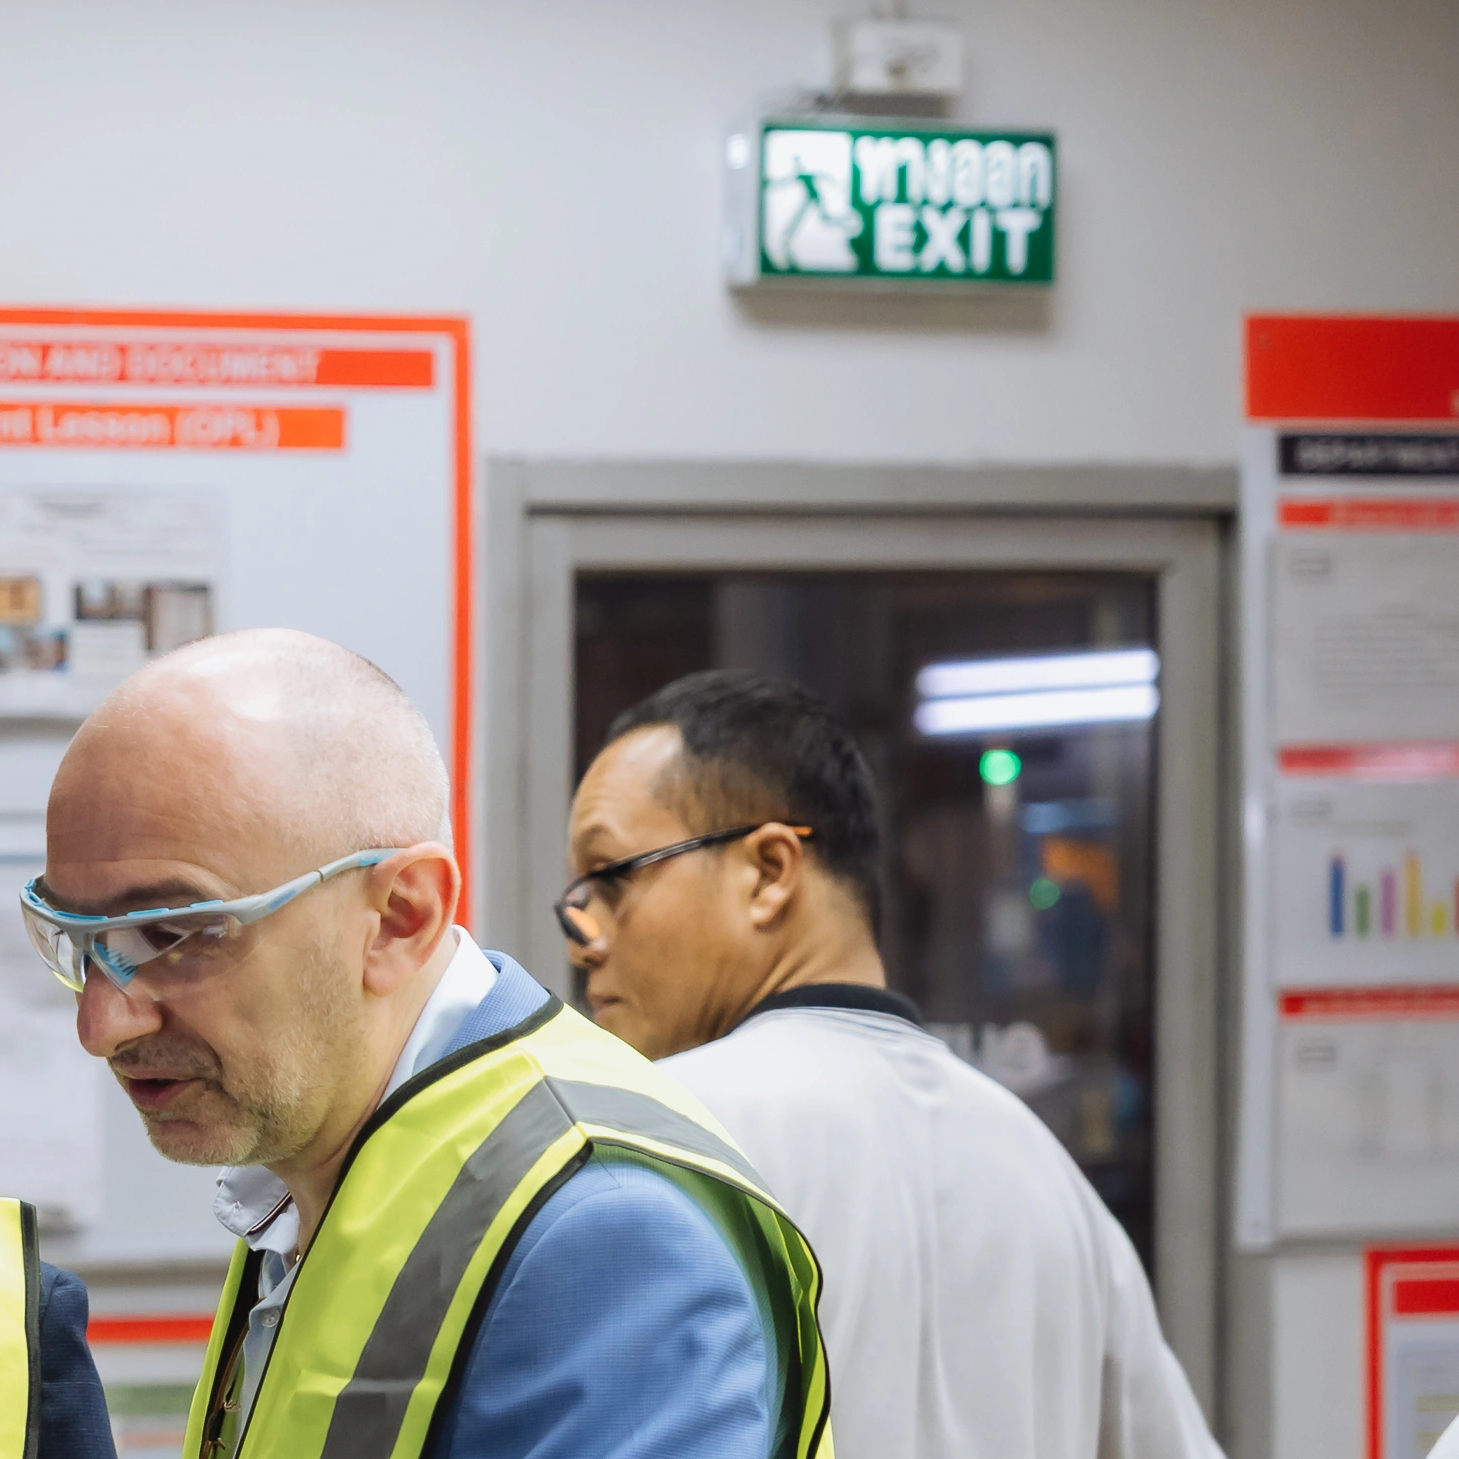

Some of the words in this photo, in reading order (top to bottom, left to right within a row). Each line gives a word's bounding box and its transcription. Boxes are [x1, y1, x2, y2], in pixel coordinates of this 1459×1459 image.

[853, 134, 1053, 207] ทางออก
[873, 201, 1041, 275] EXIT
[42, 344, 121, 382] AND
[124, 346, 322, 386] DOCUMENT
[36, 405, 171, 445] Lesson
[174, 406, 280, 450] (OPL)
